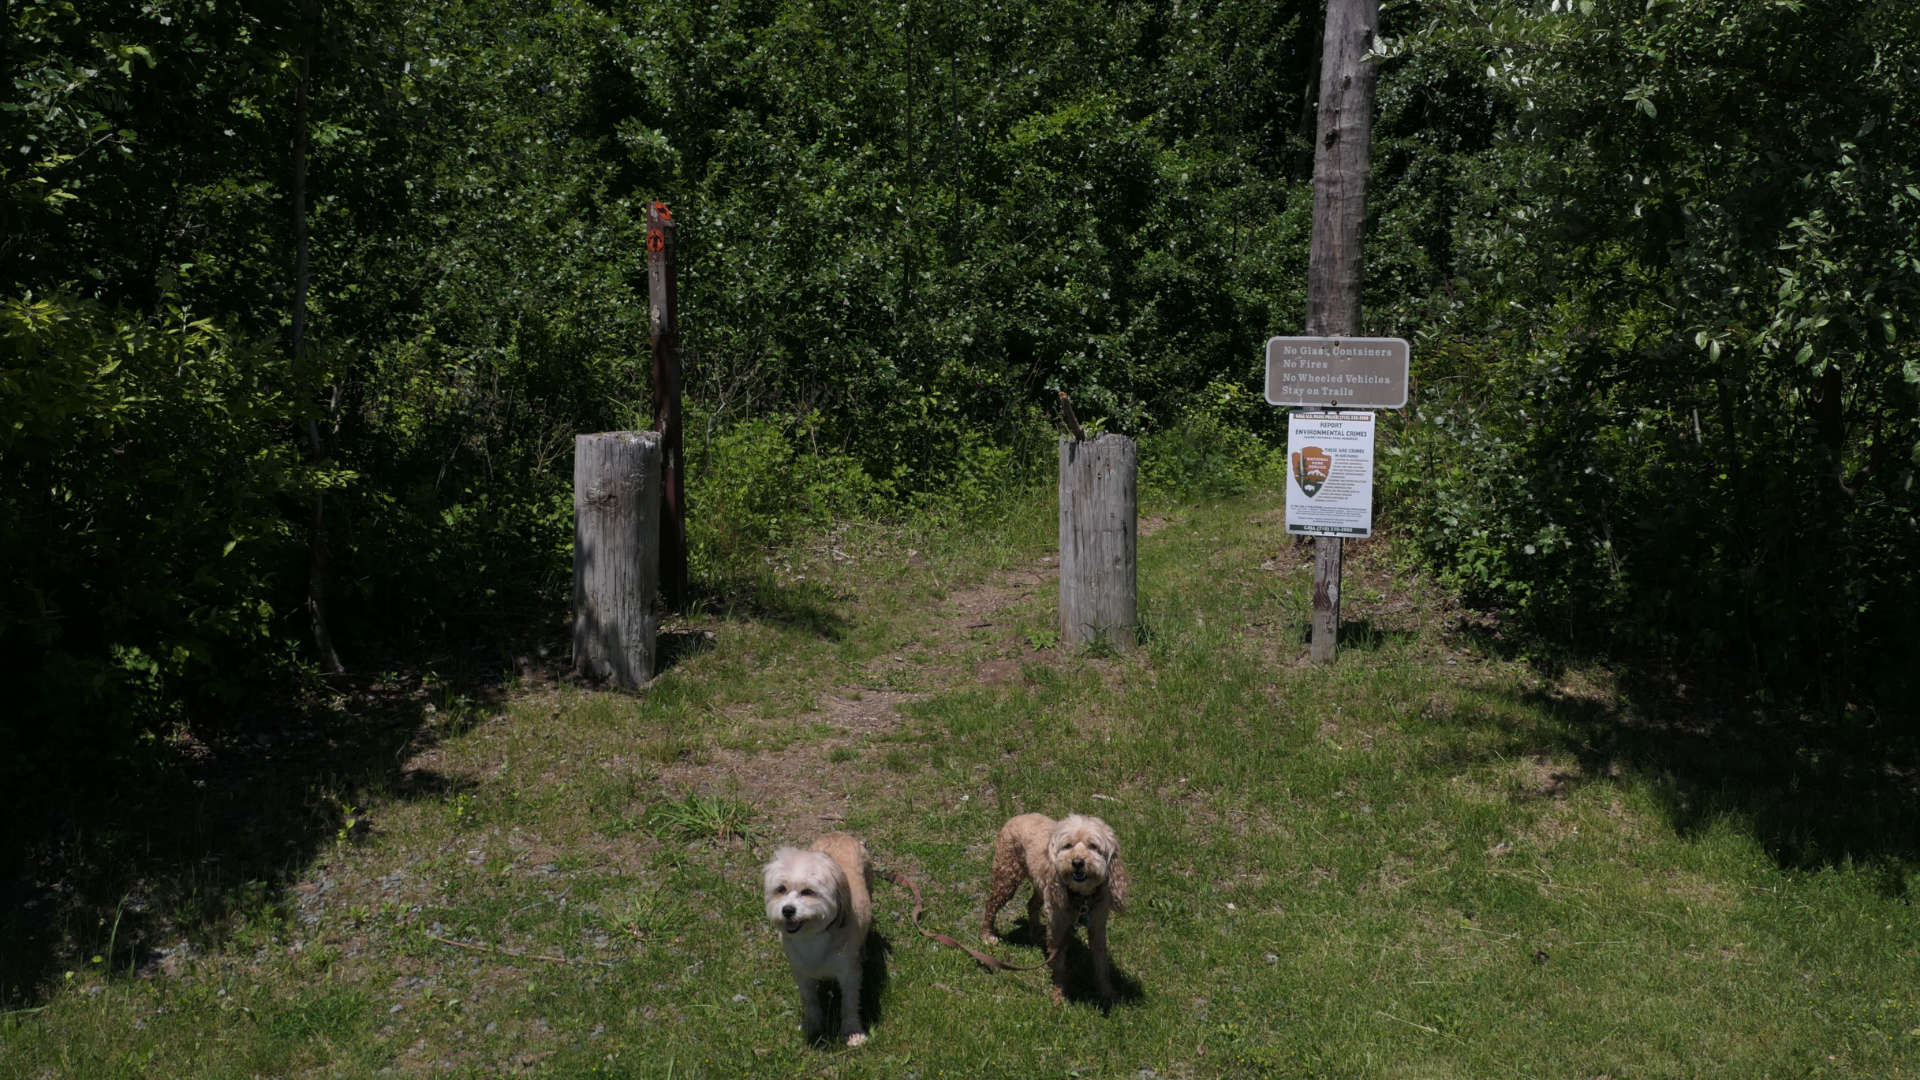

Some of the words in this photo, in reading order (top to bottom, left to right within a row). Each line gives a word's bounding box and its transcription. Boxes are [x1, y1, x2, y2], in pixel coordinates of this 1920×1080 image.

[1283, 346, 1297, 355] No
[1332, 346, 1392, 357] Containers
[1283, 359, 1297, 368] No
[1299, 360, 1328, 369] Fires
[1283, 373, 1296, 382] No
[1297, 374, 1343, 384] Wheeled
[1345, 374, 1391, 384] Vehicles
[1282, 385, 1304, 396] Stay
[1321, 387, 1353, 396] Trails
[1295, 429, 1344, 437] ENVIRONMENTAL
[1346, 430, 1367, 438] CRIMES
